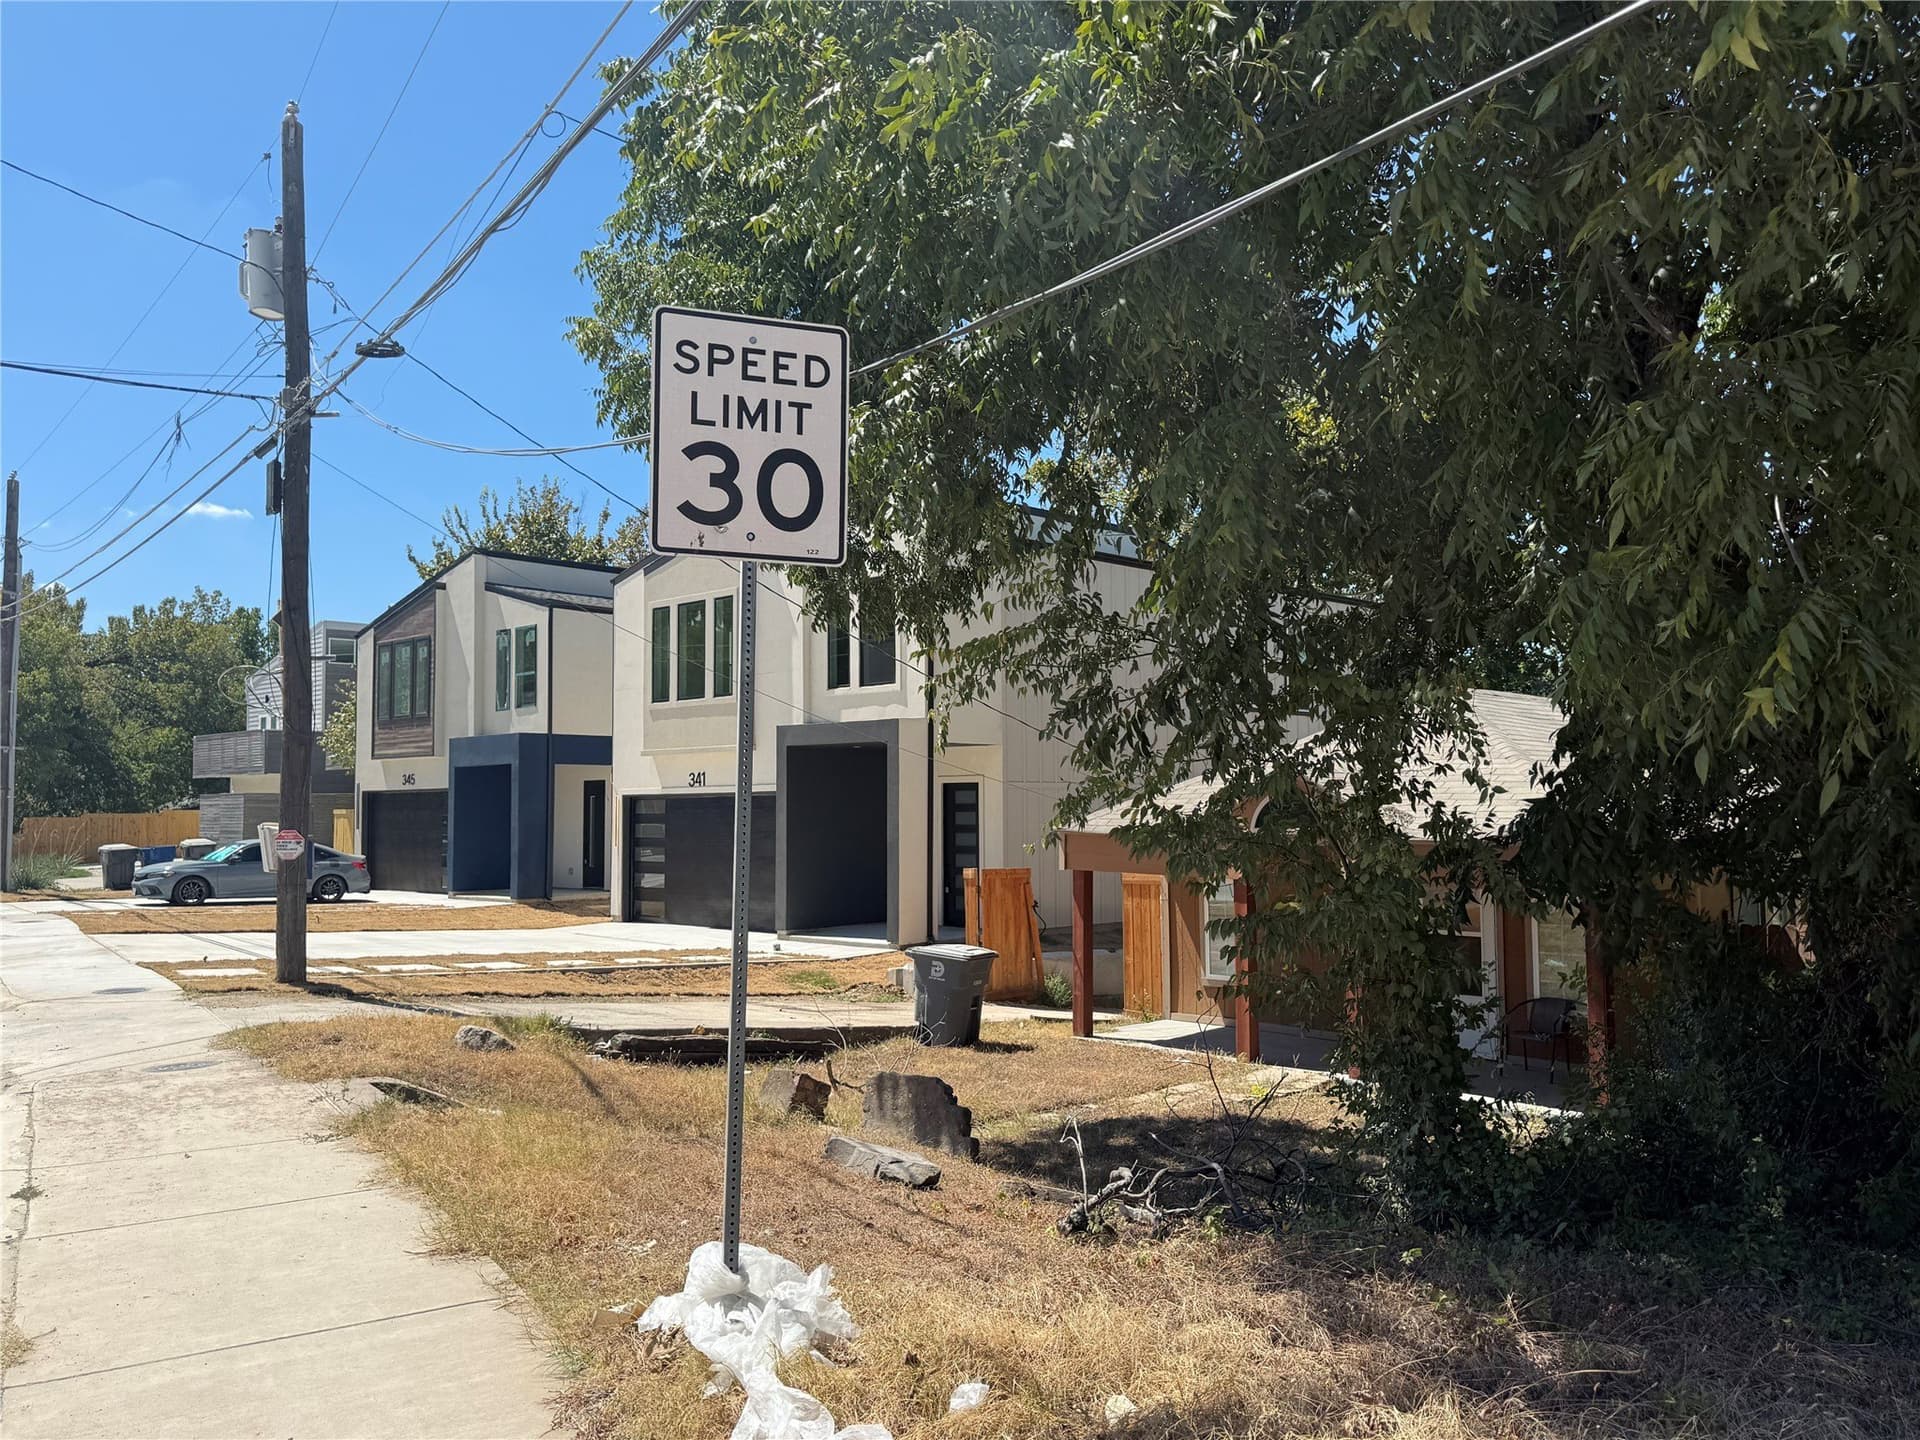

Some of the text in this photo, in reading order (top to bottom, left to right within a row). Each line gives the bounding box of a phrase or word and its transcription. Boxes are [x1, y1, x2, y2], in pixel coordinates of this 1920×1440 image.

[673, 340, 830, 388] SPEED
[691, 391, 812, 435] LIMIT
[677, 441, 824, 532] 30
[402, 773, 416, 785] 345
[688, 771, 706, 787] 341
